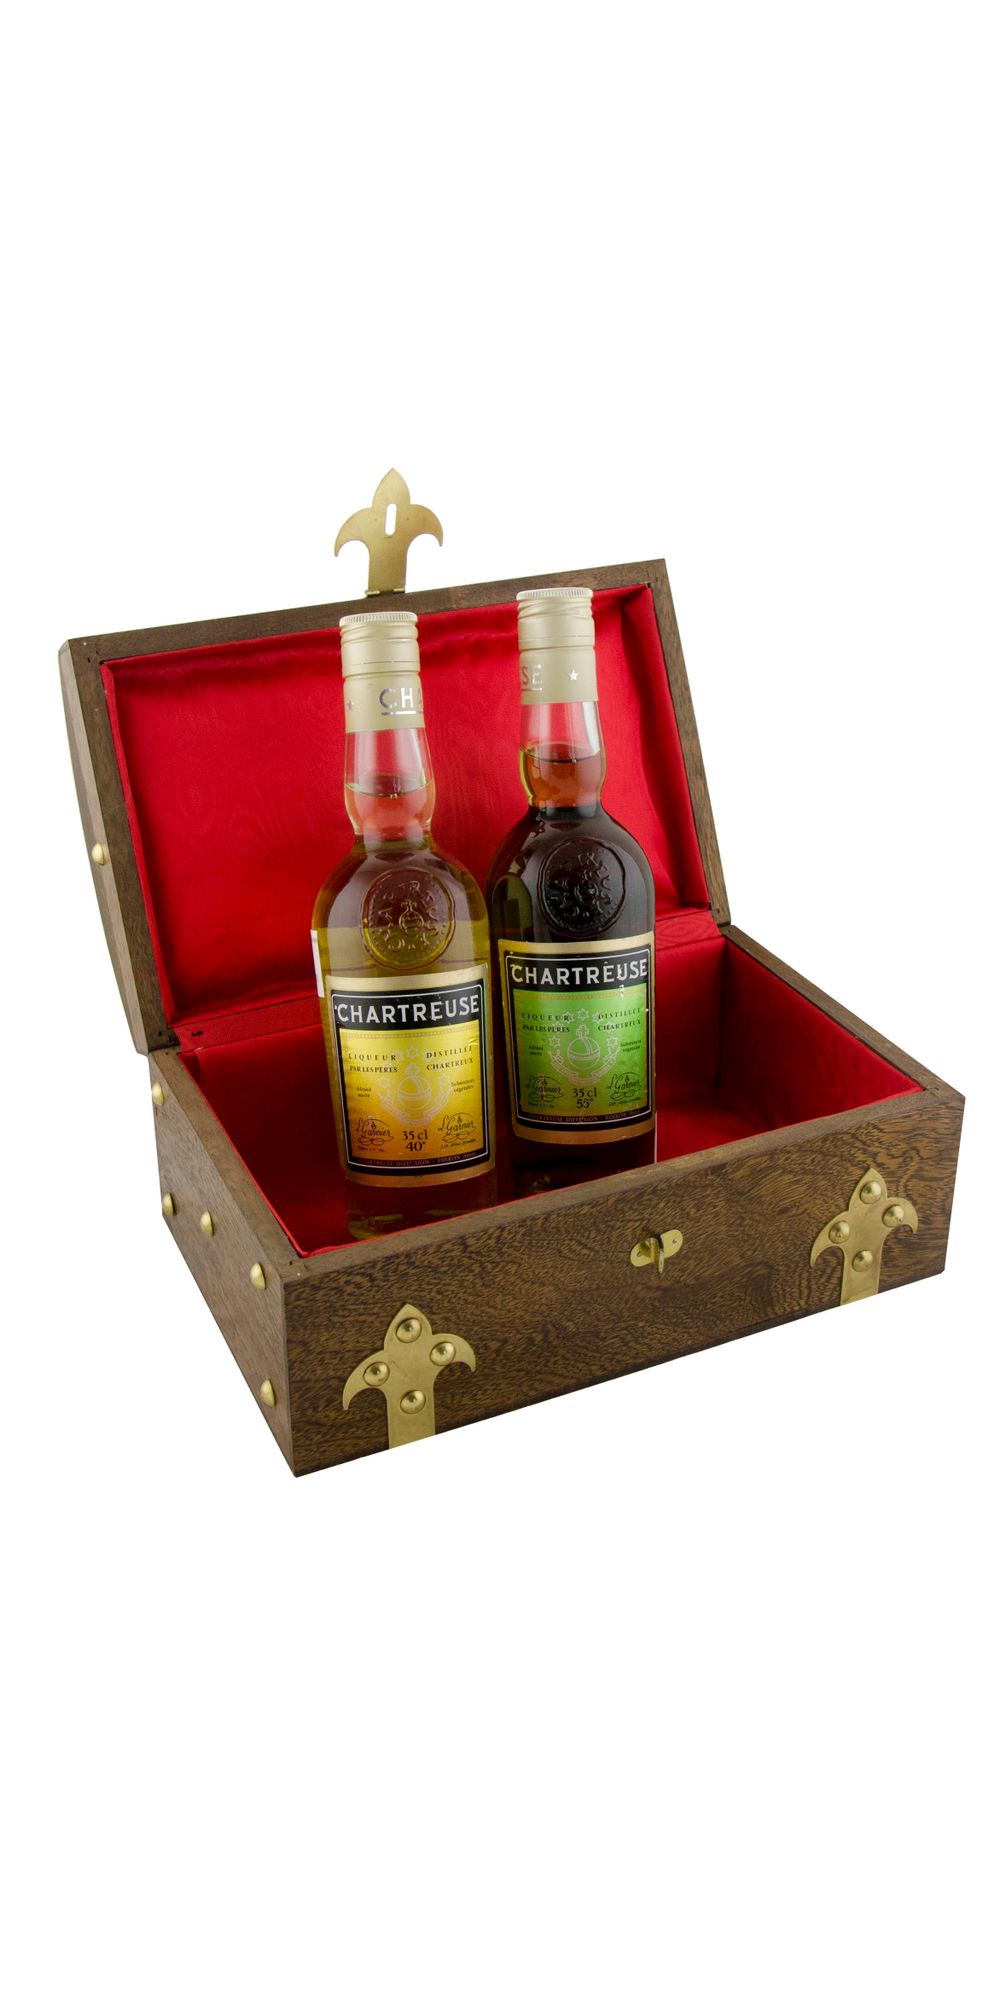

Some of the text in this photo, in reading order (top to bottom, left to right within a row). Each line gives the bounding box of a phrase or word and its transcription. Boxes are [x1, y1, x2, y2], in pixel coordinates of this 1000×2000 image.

[379, 687, 422, 709] CH
[511, 958, 648, 985] CHARTREUSE
[337, 994, 479, 1023] CHARTREUSE
[521, 1012, 570, 1021] LIQUEUR
[598, 1020, 641, 1032] CHARTREUX
[348, 1053, 396, 1061] LIQUEUR
[426, 1057, 474, 1071] CHARTREUX
[573, 1087, 597, 1098] 35 cl
[402, 1129, 428, 1141] 35 cl
